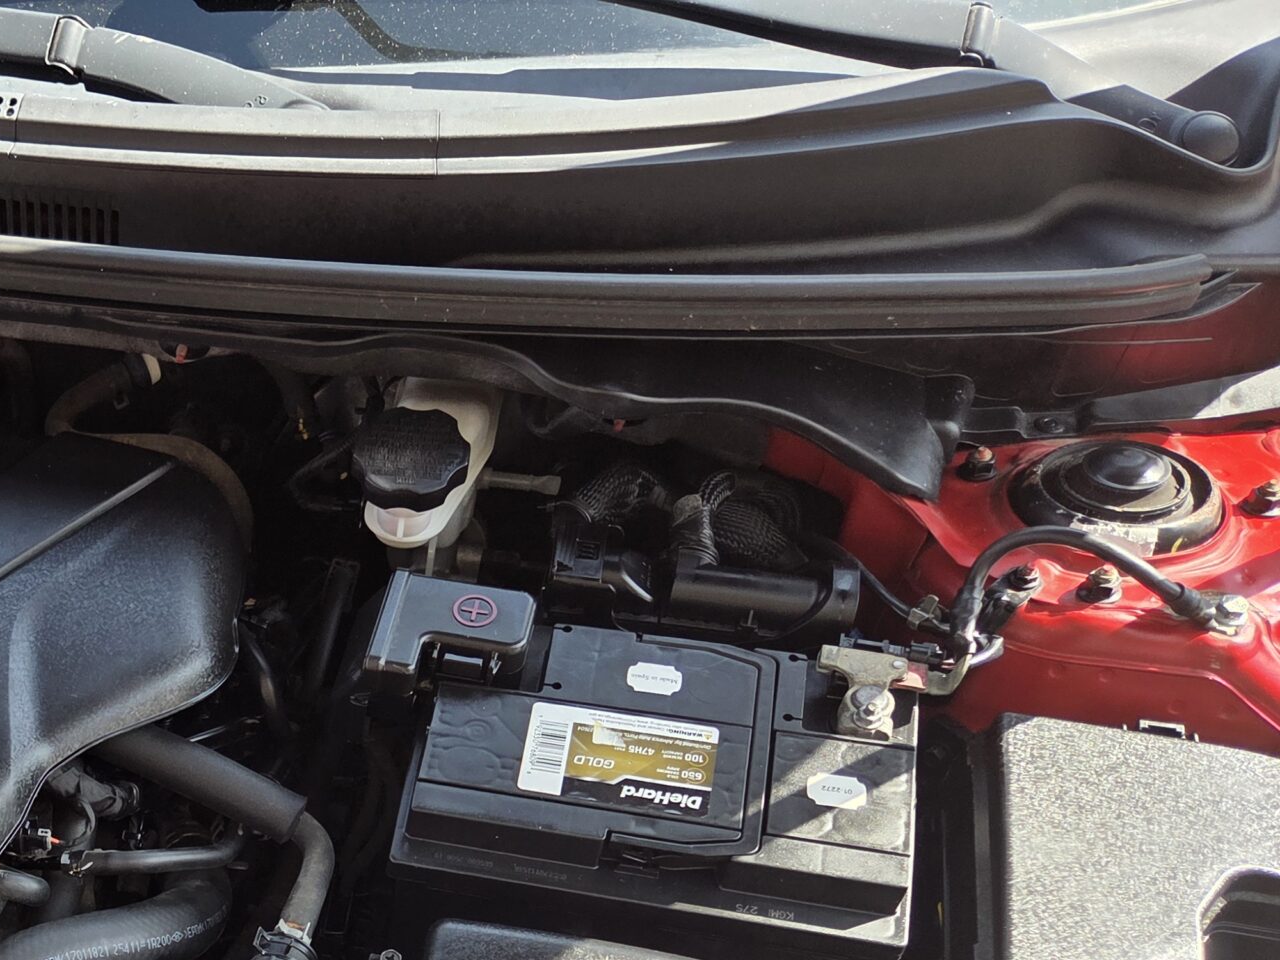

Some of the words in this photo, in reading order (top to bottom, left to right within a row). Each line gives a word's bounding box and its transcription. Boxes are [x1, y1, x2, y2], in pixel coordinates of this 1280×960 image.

[628, 745, 656, 756] 47H5
[573, 754, 616, 769] GOLD
[684, 752, 704, 764] 100
[681, 769, 703, 782] 650
[619, 784, 703, 810] DieHard
